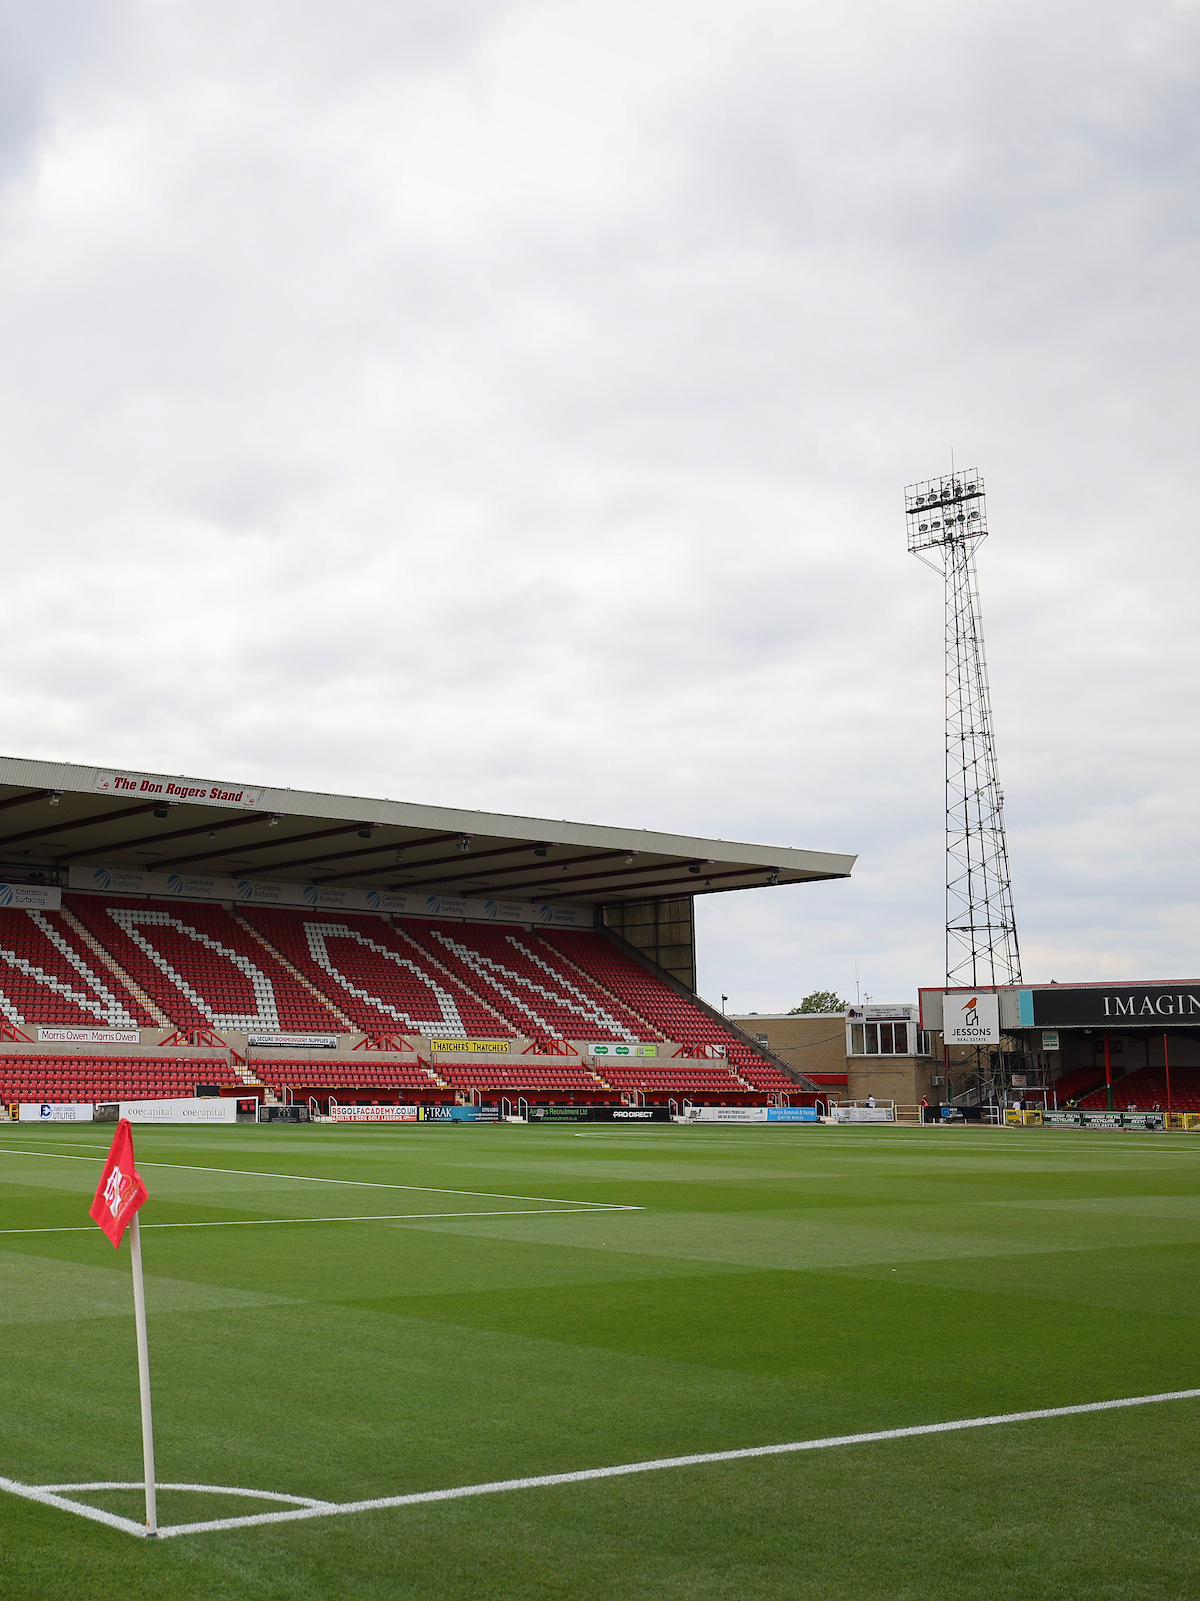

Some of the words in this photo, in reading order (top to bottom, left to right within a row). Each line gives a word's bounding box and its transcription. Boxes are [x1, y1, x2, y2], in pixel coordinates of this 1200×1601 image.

[114, 777, 136, 790] The
[140, 780, 162, 793] Don
[166, 783, 206, 798] Rogers
[210, 788, 243, 802] Stand
[113, 880, 140, 889] Surfacing
[16, 888, 48, 897] Coatstone
[185, 886, 211, 894] Surfacing
[254, 891, 279, 899] Surfacing
[16, 896, 45, 905] Surfacing
[382, 901, 404, 909] Surfacing
[442, 906, 464, 914] Surfacing
[42, 1031, 65, 1040] Morris
[67, 1031, 88, 1040] Owen
[92, 1032, 114, 1040] Morris
[116, 1032, 136, 1041] Owen
[433, 1042, 468, 1051] THATCHERS
[473, 1043, 507, 1052] THATCHERS
[128, 1107, 172, 1118] coecapital
[183, 1107, 225, 1119] coecapital
